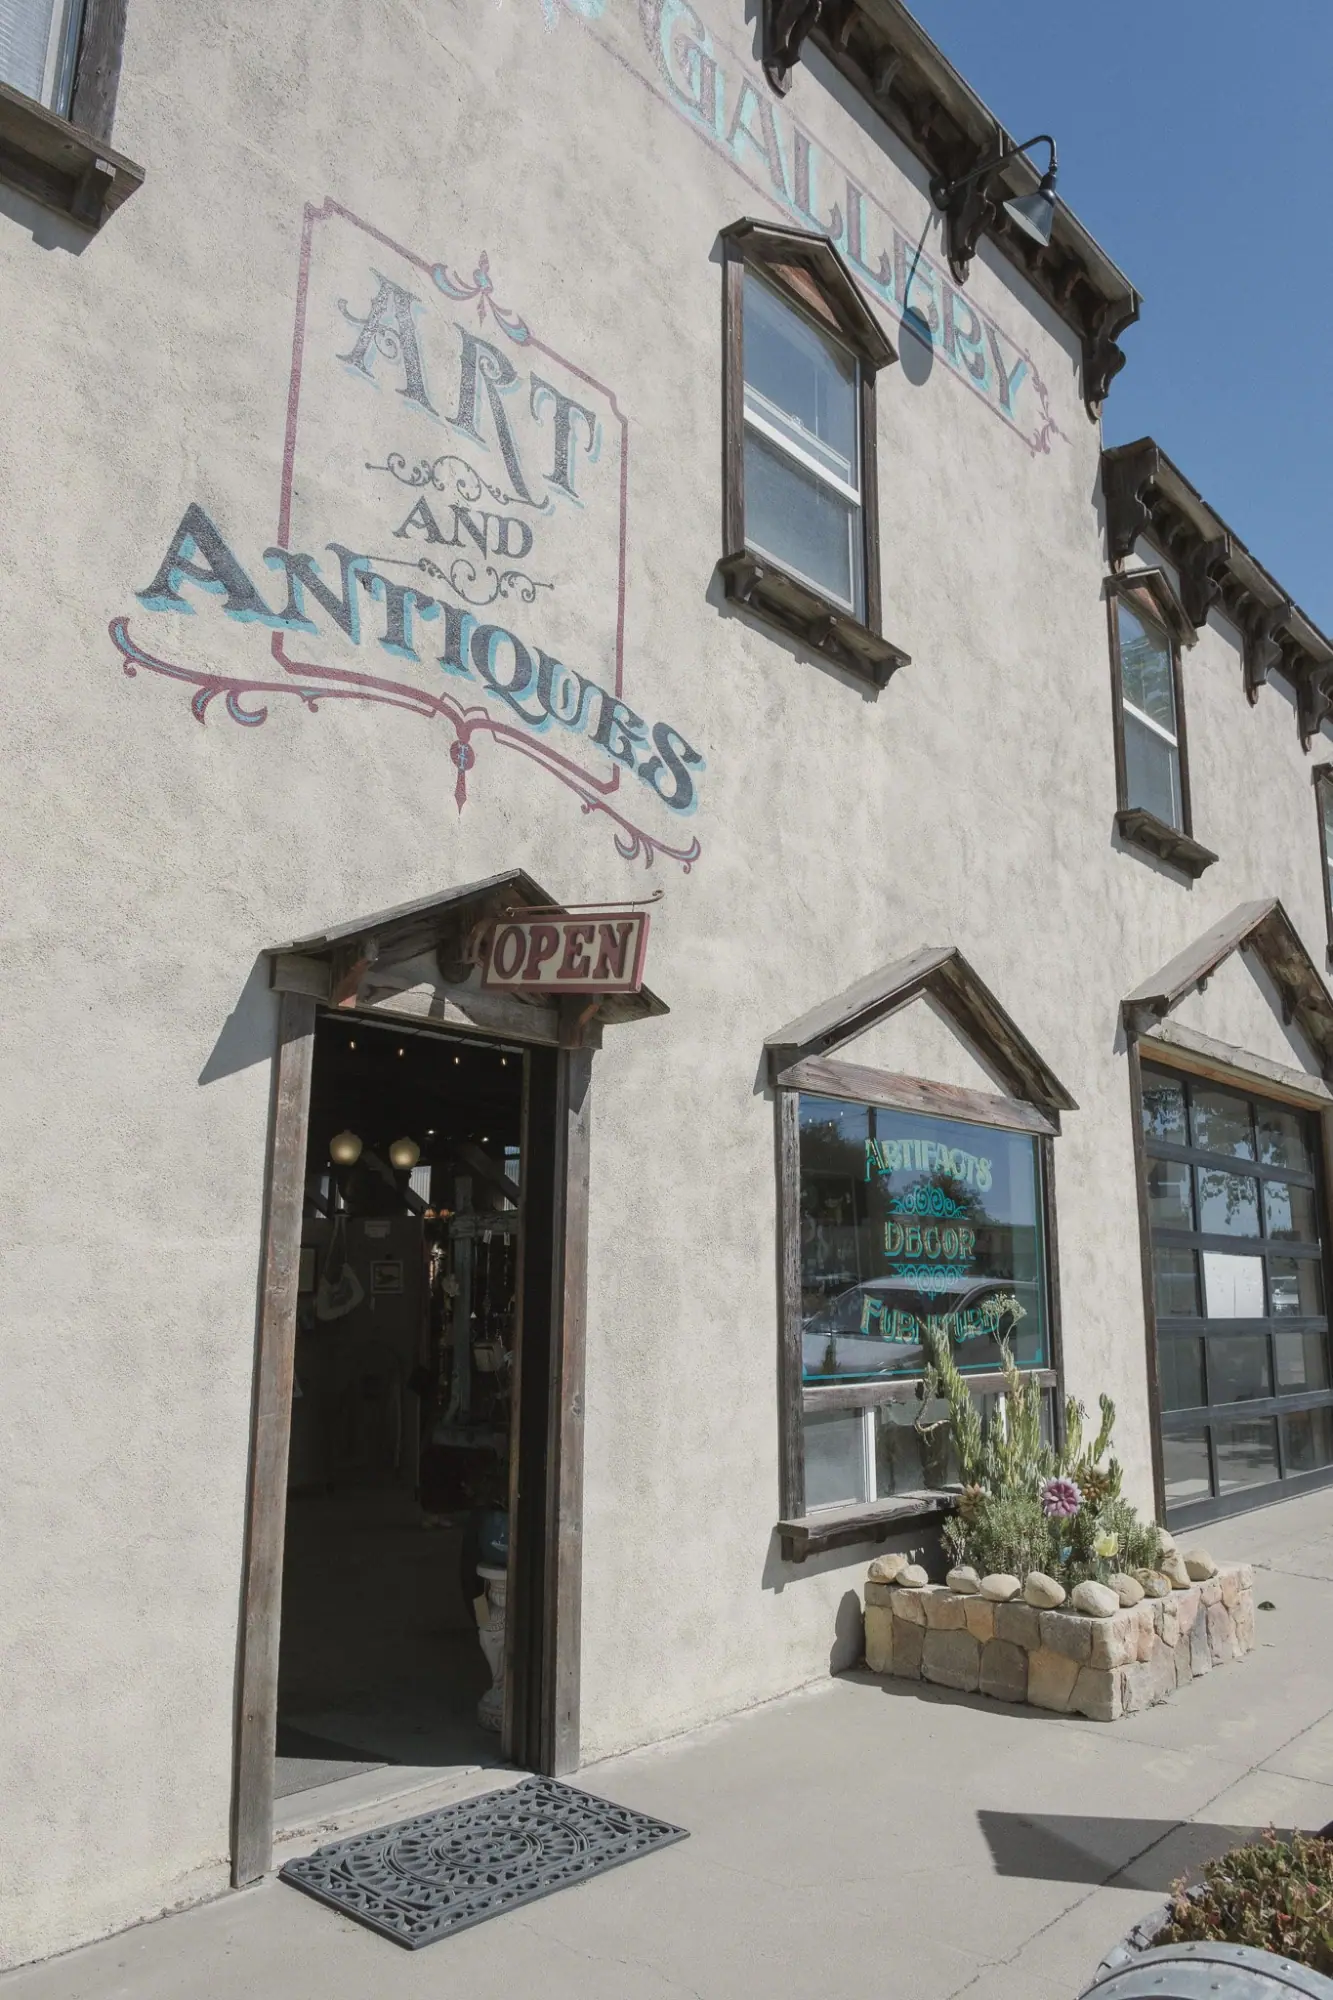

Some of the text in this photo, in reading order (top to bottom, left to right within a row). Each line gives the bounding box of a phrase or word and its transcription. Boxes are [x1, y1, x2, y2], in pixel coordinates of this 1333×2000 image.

[638, 0, 1029, 416] GALLERY
[335, 267, 600, 514] ART
[392, 495, 533, 561] AND
[135, 502, 706, 815] ANTIQUES
[493, 922, 633, 980] OPEN
[864, 1137, 993, 1192] ARTIFACTS
[883, 1221, 976, 1260] DECOR
[860, 1294, 999, 1344] FURNURE
